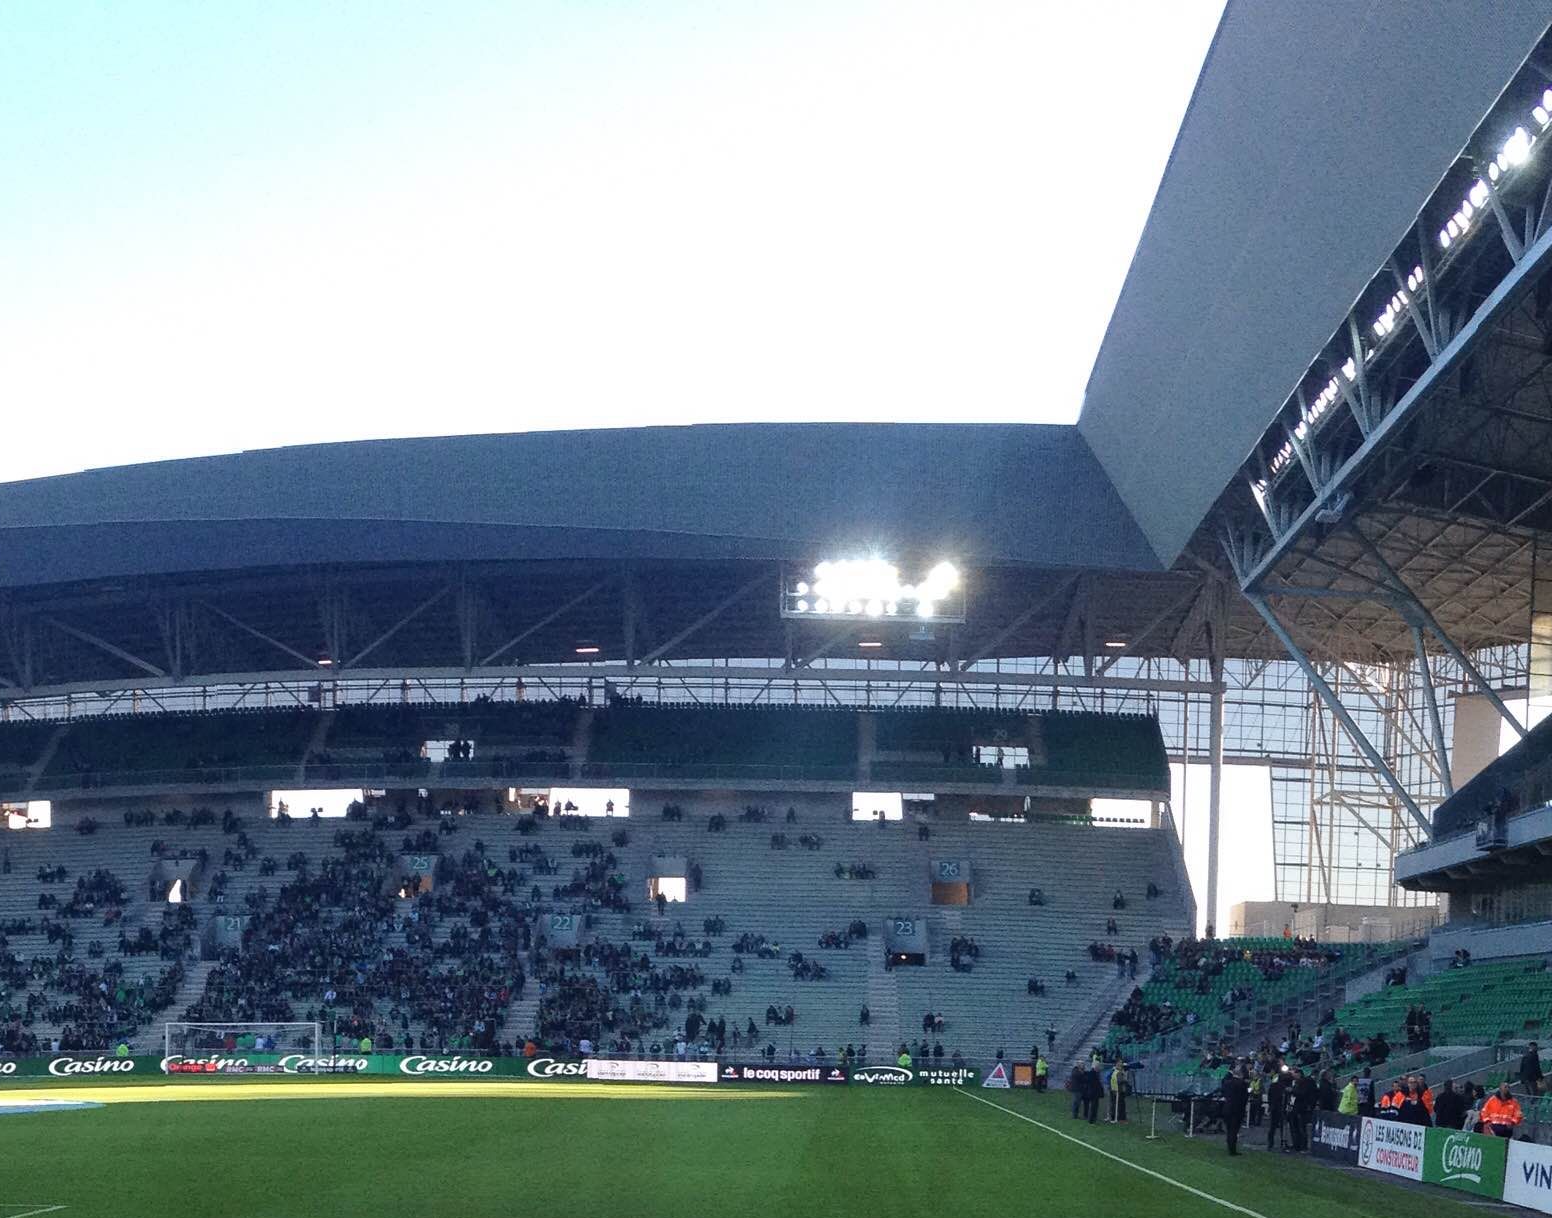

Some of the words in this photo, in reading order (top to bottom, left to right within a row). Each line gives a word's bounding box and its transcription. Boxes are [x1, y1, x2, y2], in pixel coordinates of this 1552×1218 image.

[413, 856, 428, 869] 25
[226, 917, 241, 930] 21
[553, 916, 570, 930] 22
[896, 921, 913, 935] 23
[48, 1057, 134, 1076] Casino
[399, 1055, 493, 1075] Casino
[756, 1069, 778, 1081] coq
[780, 1068, 820, 1081] sportif
[919, 1068, 974, 1079] mutuelle
[1441, 1133, 1483, 1174] Casino
